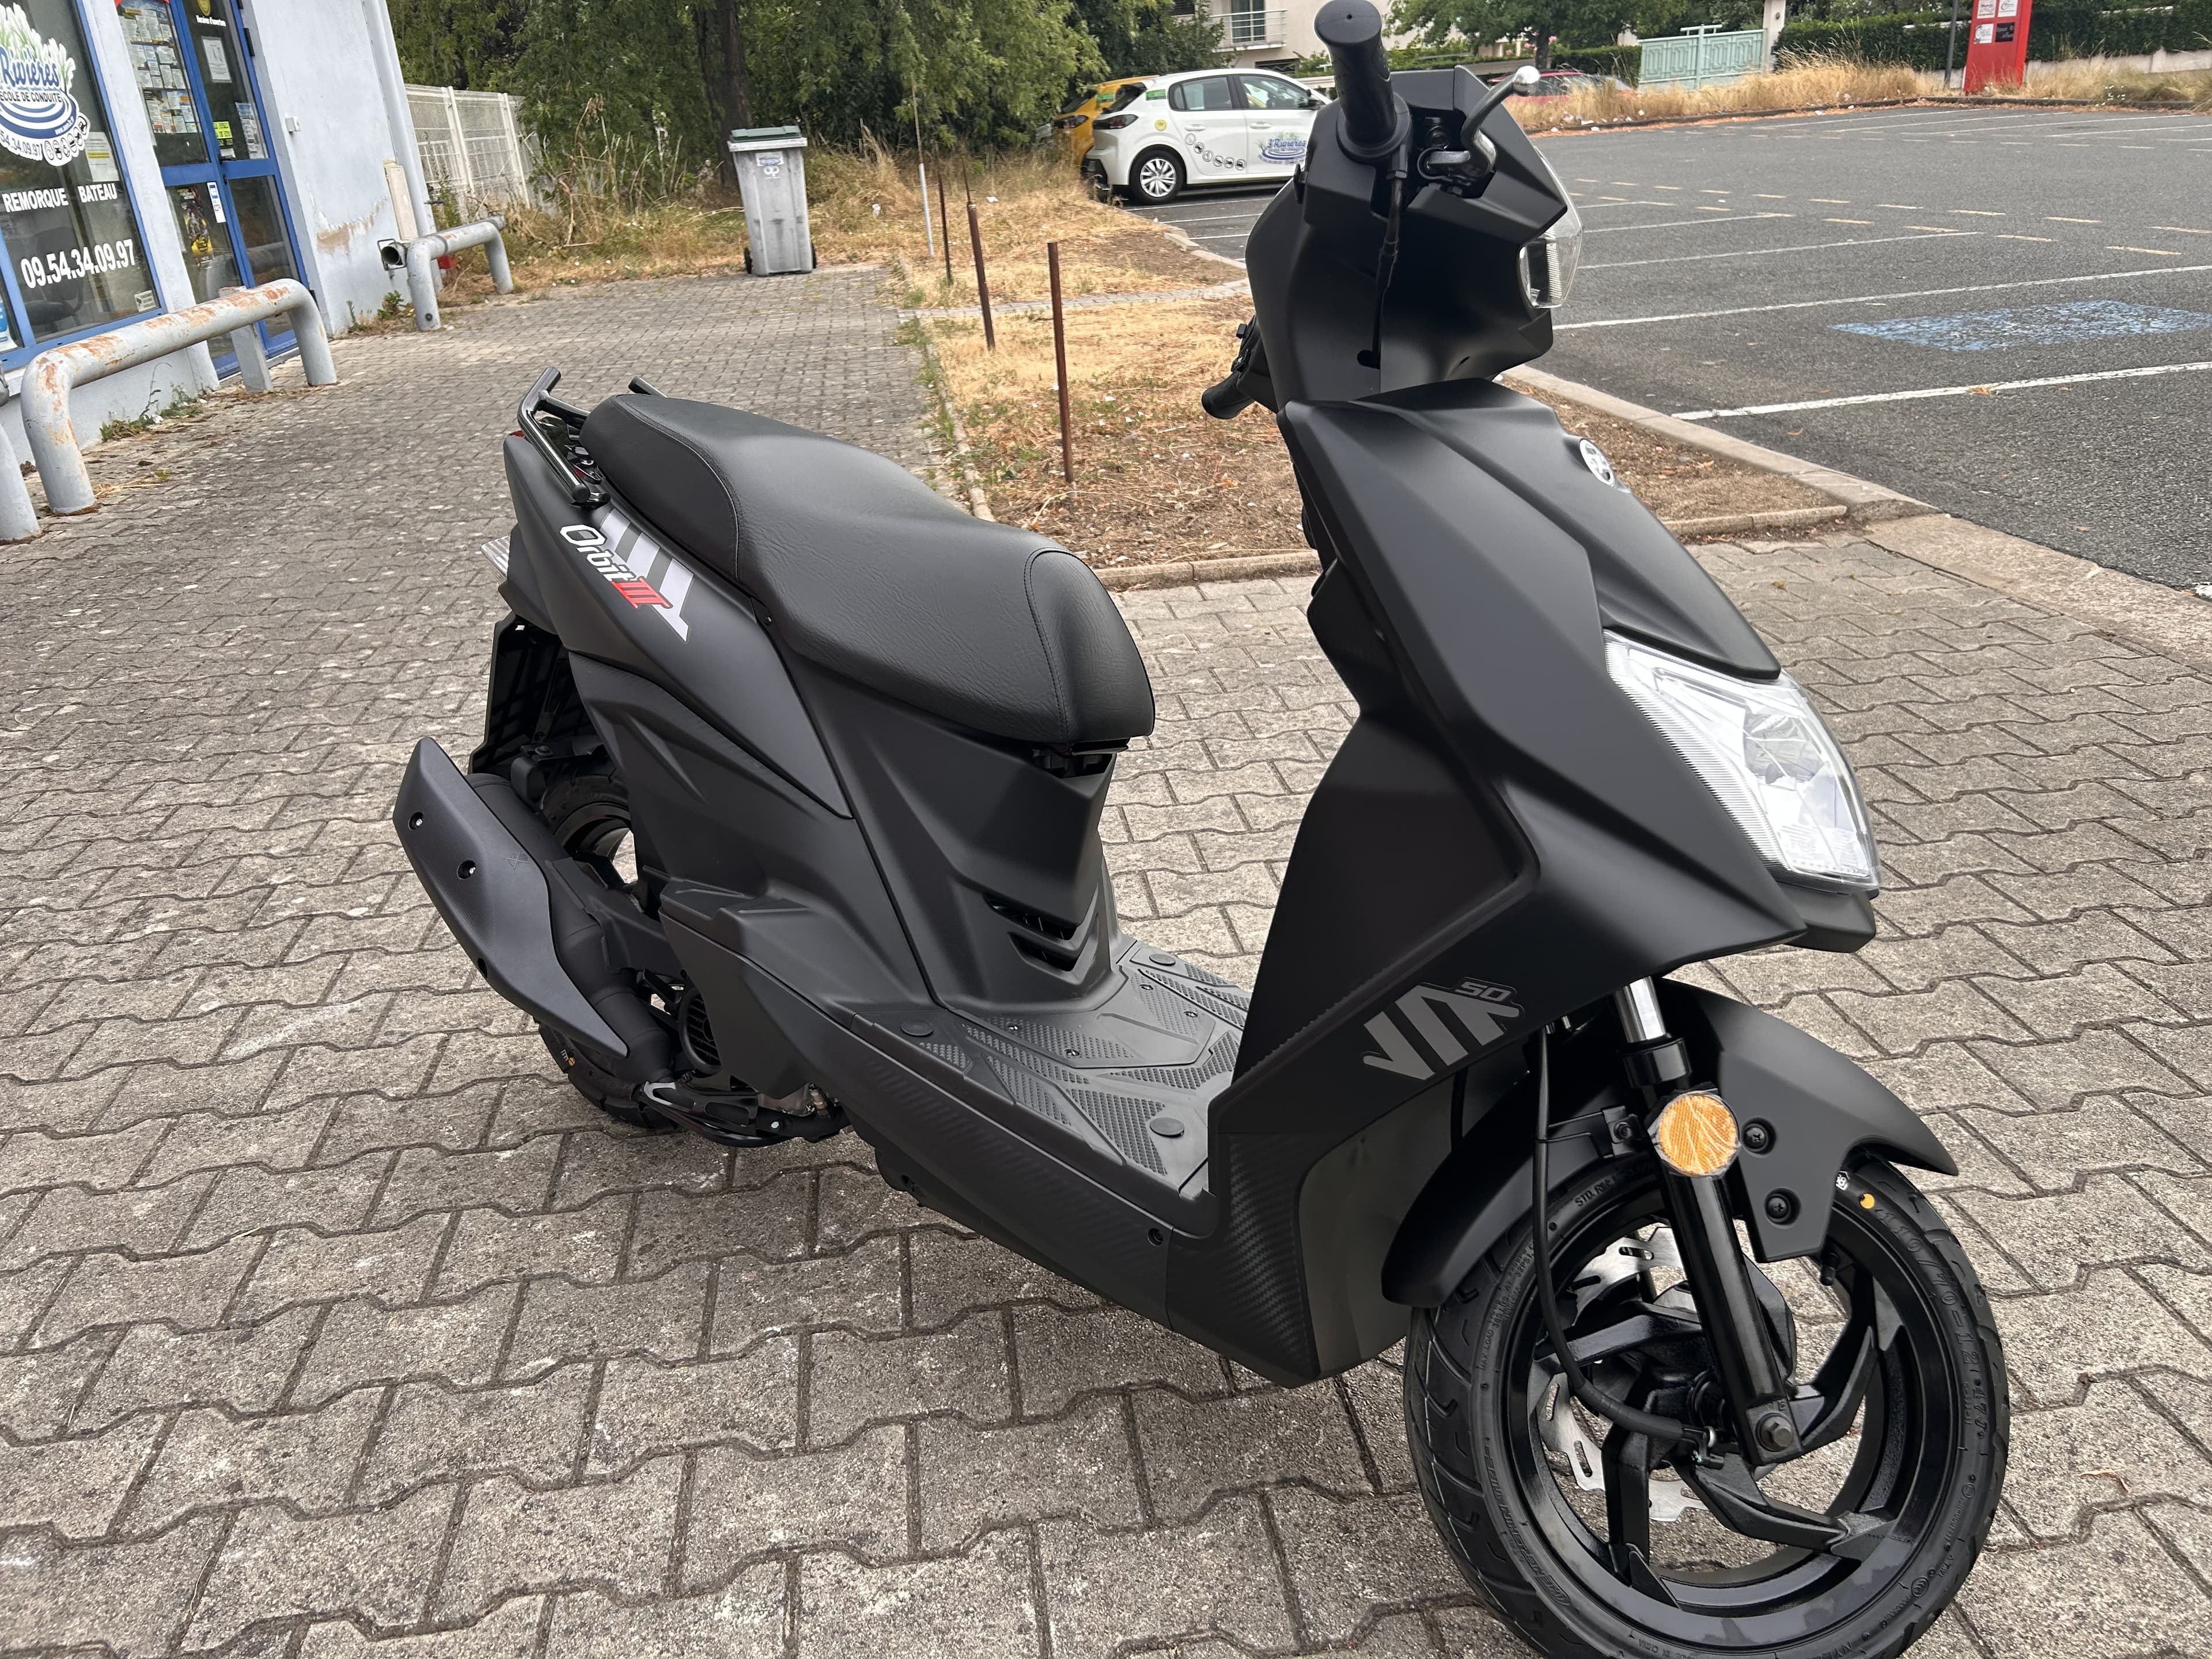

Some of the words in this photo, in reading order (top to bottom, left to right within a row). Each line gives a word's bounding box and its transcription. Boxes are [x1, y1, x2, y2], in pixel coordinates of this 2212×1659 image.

[21, 92, 31, 101] DE
[31, 92, 62, 103] CONDUITE
[2, 188, 69, 213] REMORQUE
[77, 183, 118, 203] BATEAU
[21, 239, 135, 288] 09.54.34.09.97
[559, 524, 636, 582] Orbit
[1455, 981, 1512, 1001] 50
[1880, 1211, 1979, 1365] 110/70-12
[1484, 1330, 1494, 1350] LOAD
